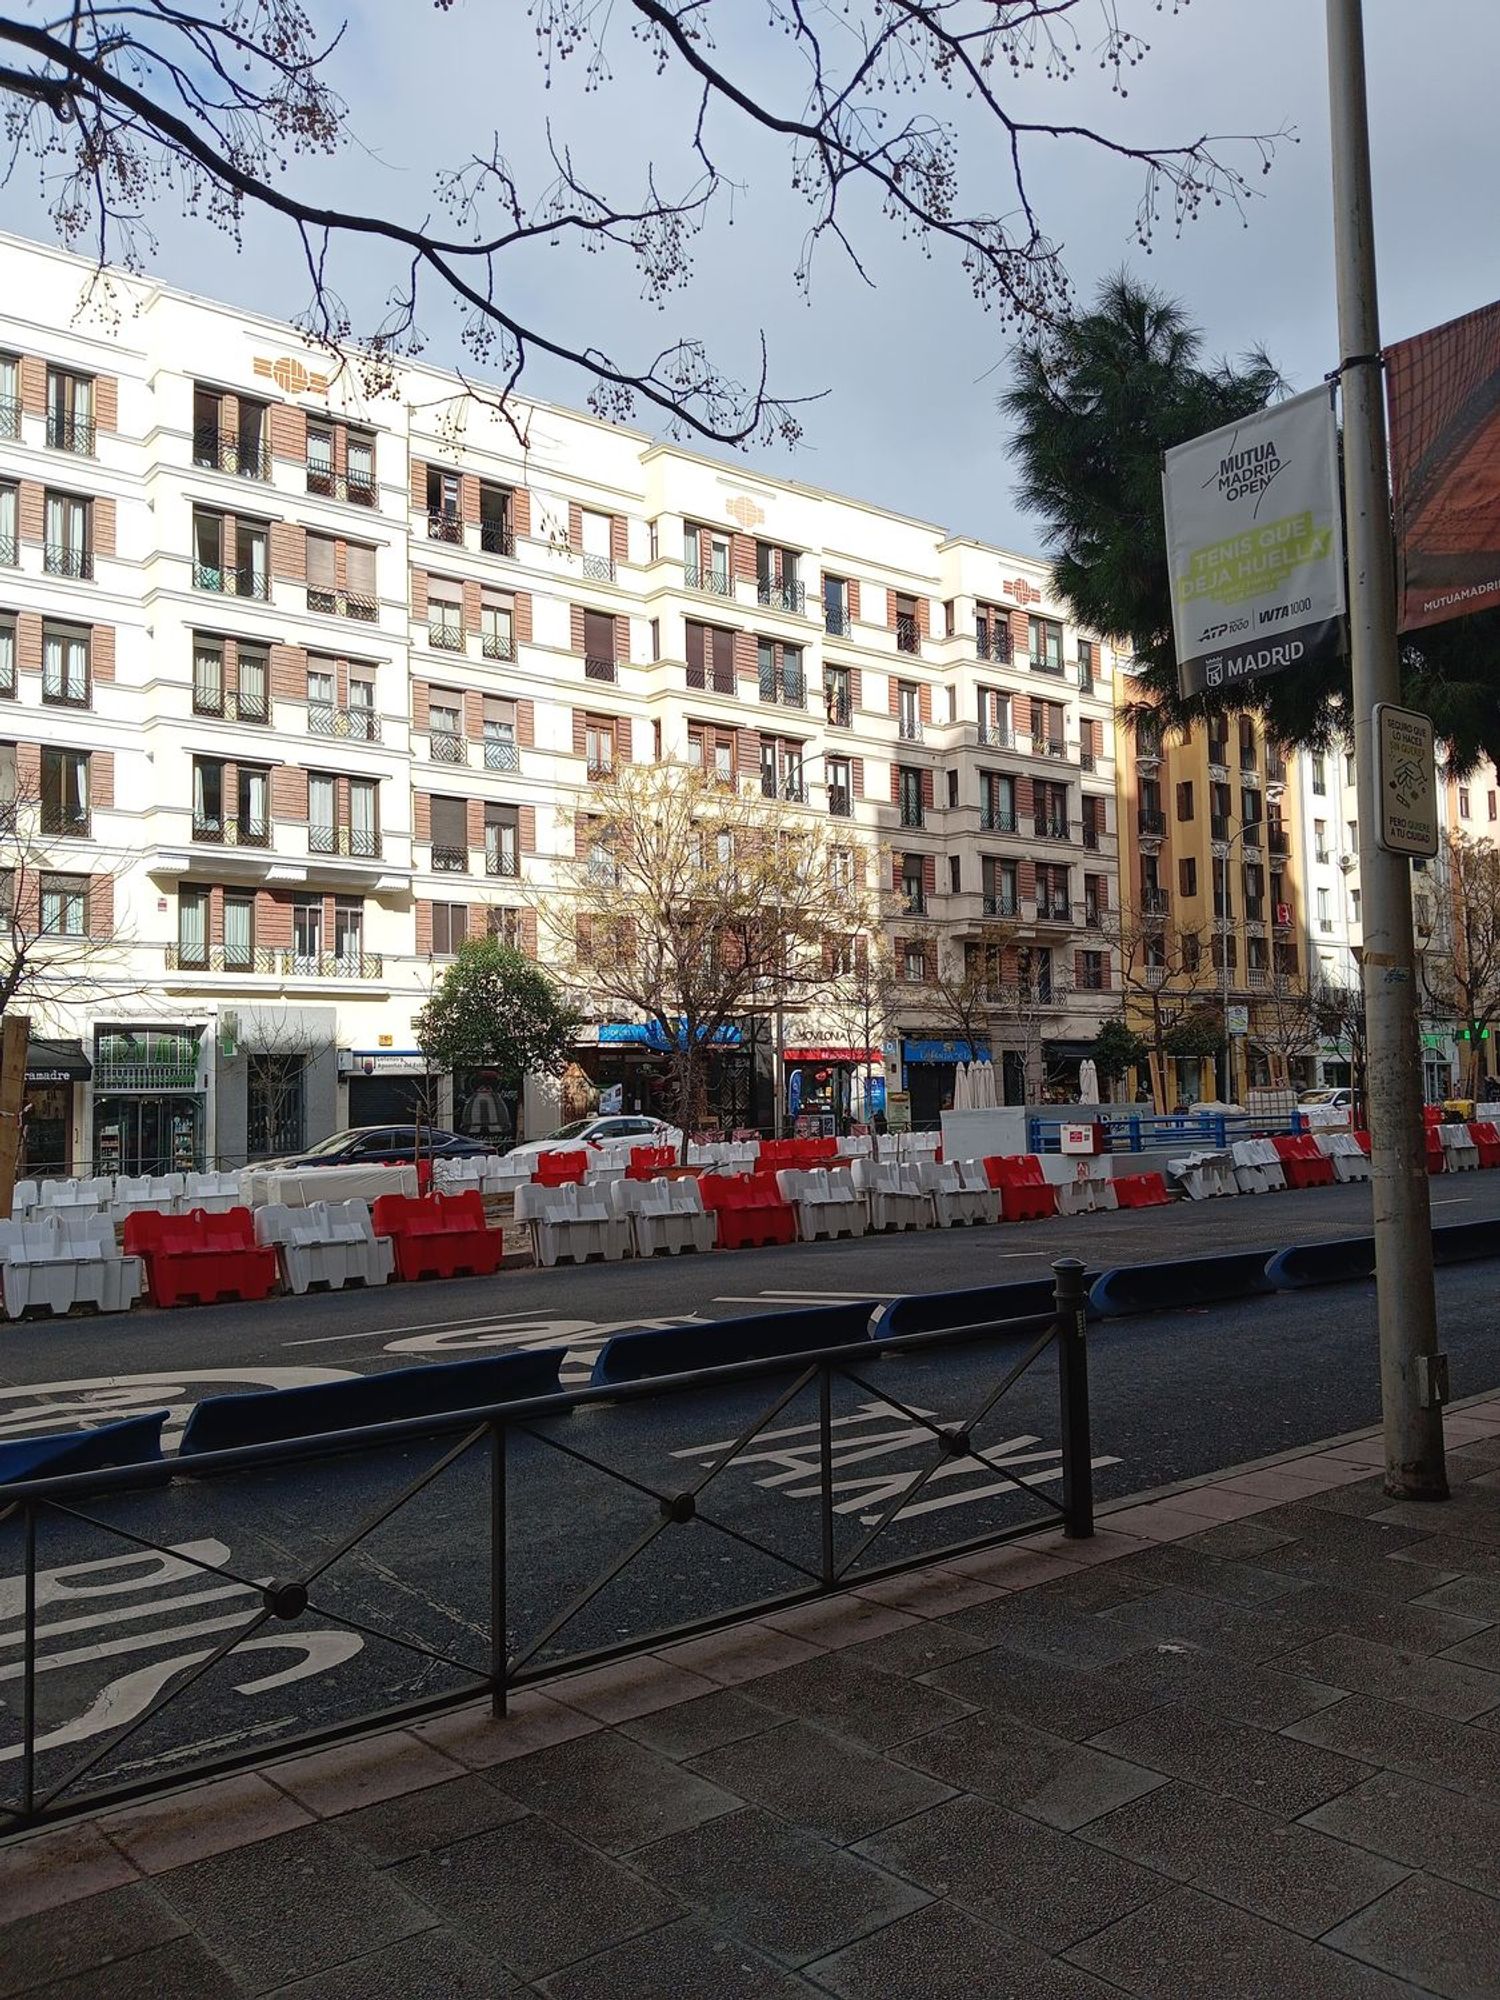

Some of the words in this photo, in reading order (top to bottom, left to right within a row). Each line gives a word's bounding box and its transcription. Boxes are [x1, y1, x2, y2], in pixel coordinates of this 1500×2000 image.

[1219, 441, 1277, 476] MUTUA
[1218, 458, 1281, 491] MADRID
[1226, 474, 1272, 502] OPEN
[1195, 537, 1252, 569] TENIS
[1258, 518, 1307, 546] QUE
[1182, 568, 1232, 598] DEJA
[1238, 537, 1325, 576] HUELLA
[1290, 597, 1312, 616] 1000
[1423, 580, 1500, 612] MUTUAMADRI
[1198, 624, 1228, 642] ATP
[1227, 641, 1305, 677] MADRID
[1387, 719, 1413, 733] SEGURO
[1413, 726, 1427, 738] QUE
[1392, 730, 1401, 741] LO
[1402, 733, 1423, 747] HACES
[1389, 816, 1407, 828] PERO
[1407, 820, 1431, 833] QUIERE
[1390, 828, 1396, 838] A
[1397, 828, 1405, 838] TU
[1406, 830, 1431, 843] CIUDAD
[24, 1069, 71, 1081] ramadre
[669, 1400, 1125, 1527] TAXI
